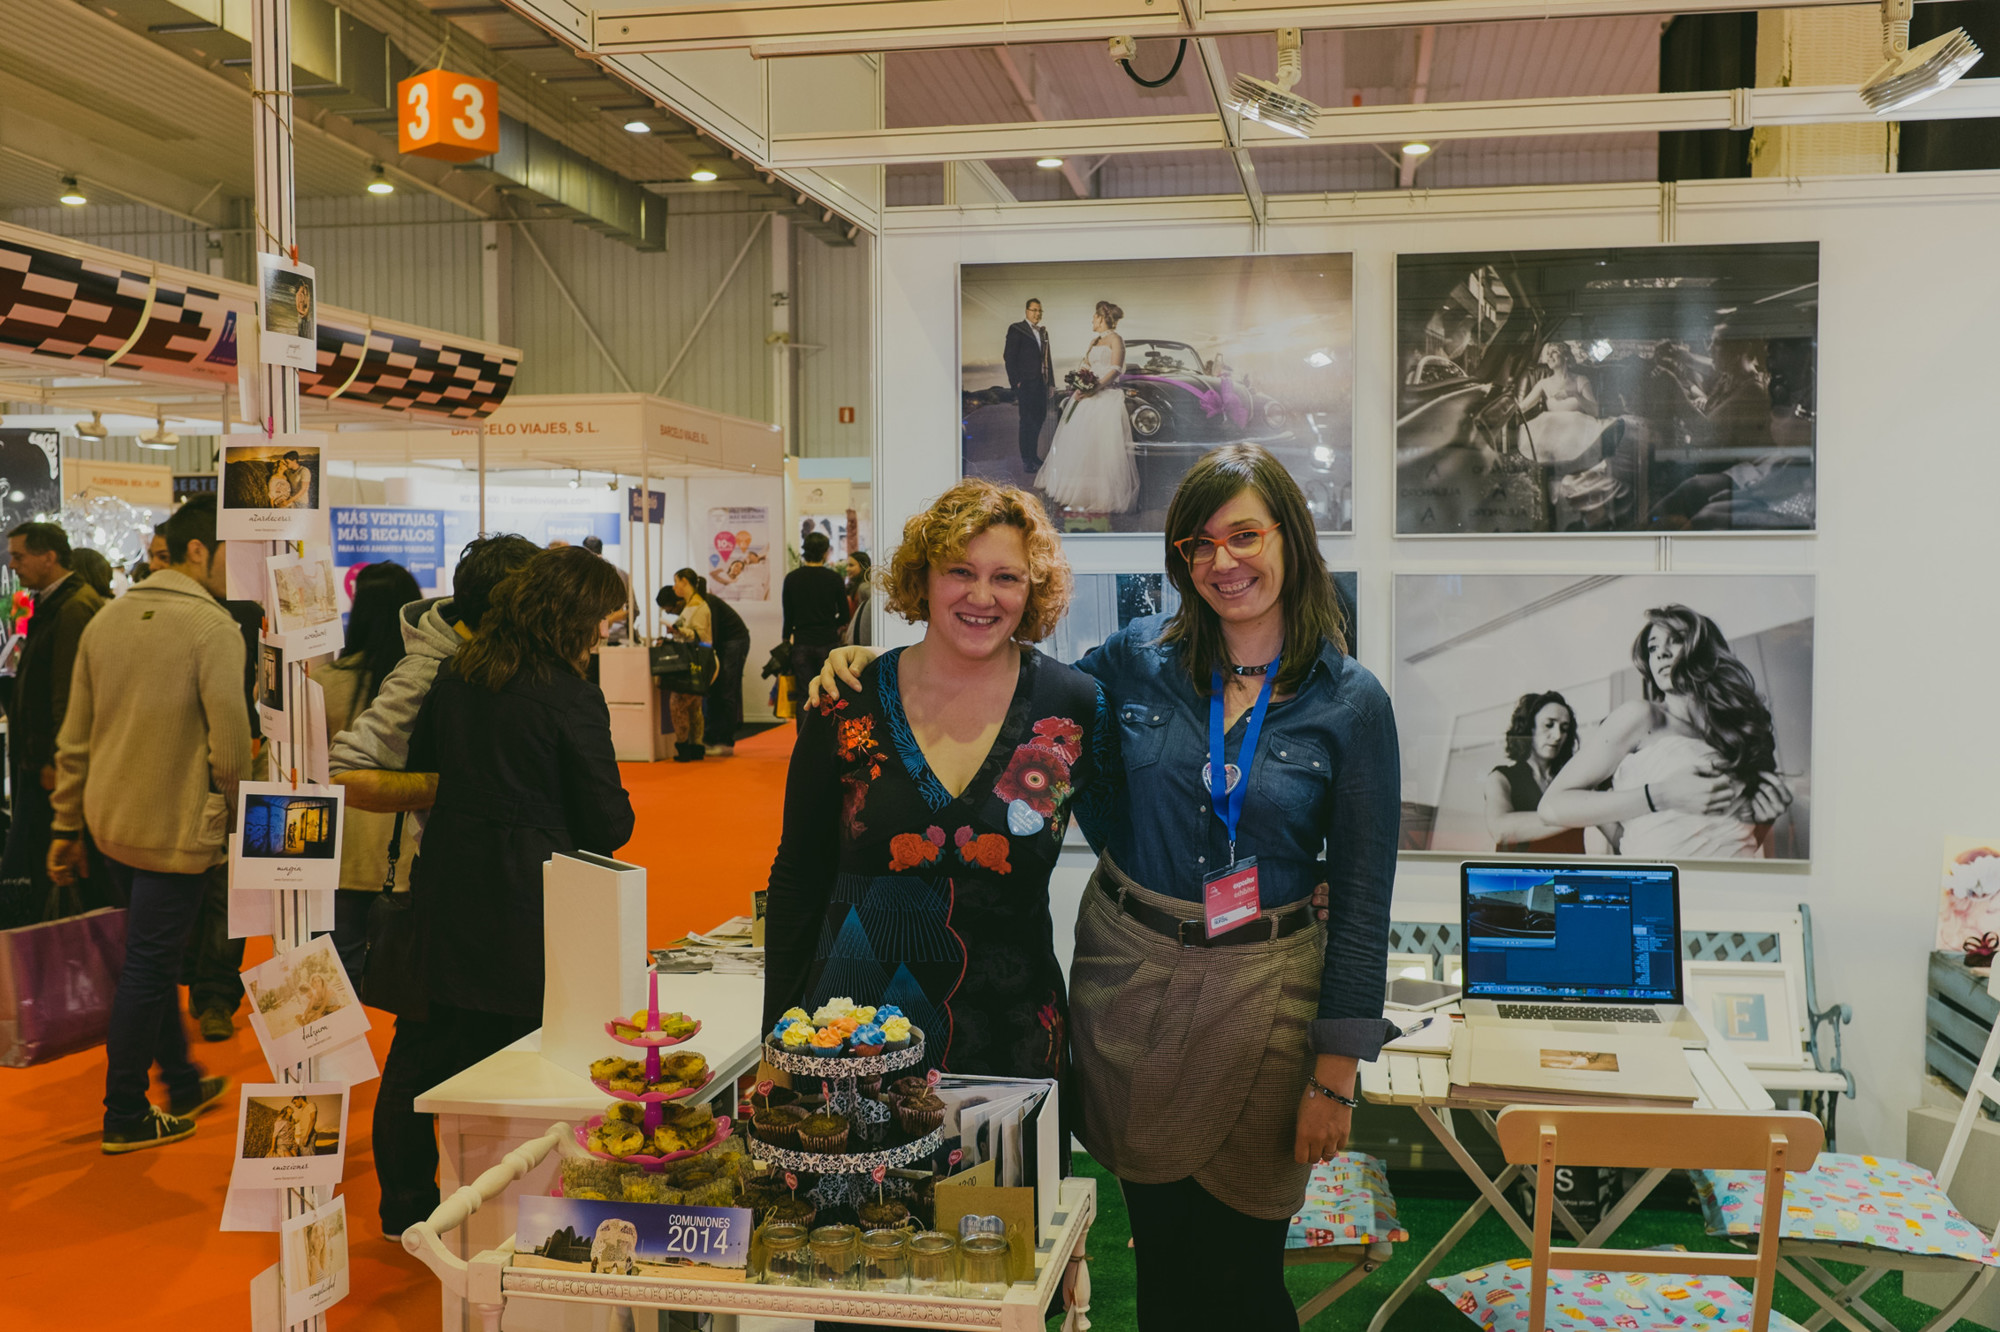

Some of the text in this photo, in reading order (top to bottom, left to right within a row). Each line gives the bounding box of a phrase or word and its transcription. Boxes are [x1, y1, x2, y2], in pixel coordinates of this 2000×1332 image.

[407, 83, 430, 140] 3
[452, 83, 486, 140] 3
[520, 422, 571, 435] VIAJES,
[575, 421, 599, 433] S.L.
[337, 510, 368, 525] MÁS
[370, 511, 438, 527] VENTAJAS,
[338, 525, 435, 542] MÁS REGALOS
[1725, 996, 1757, 1039] E
[668, 1214, 731, 1229] COMUNIONES
[666, 1225, 728, 1255] 2014
